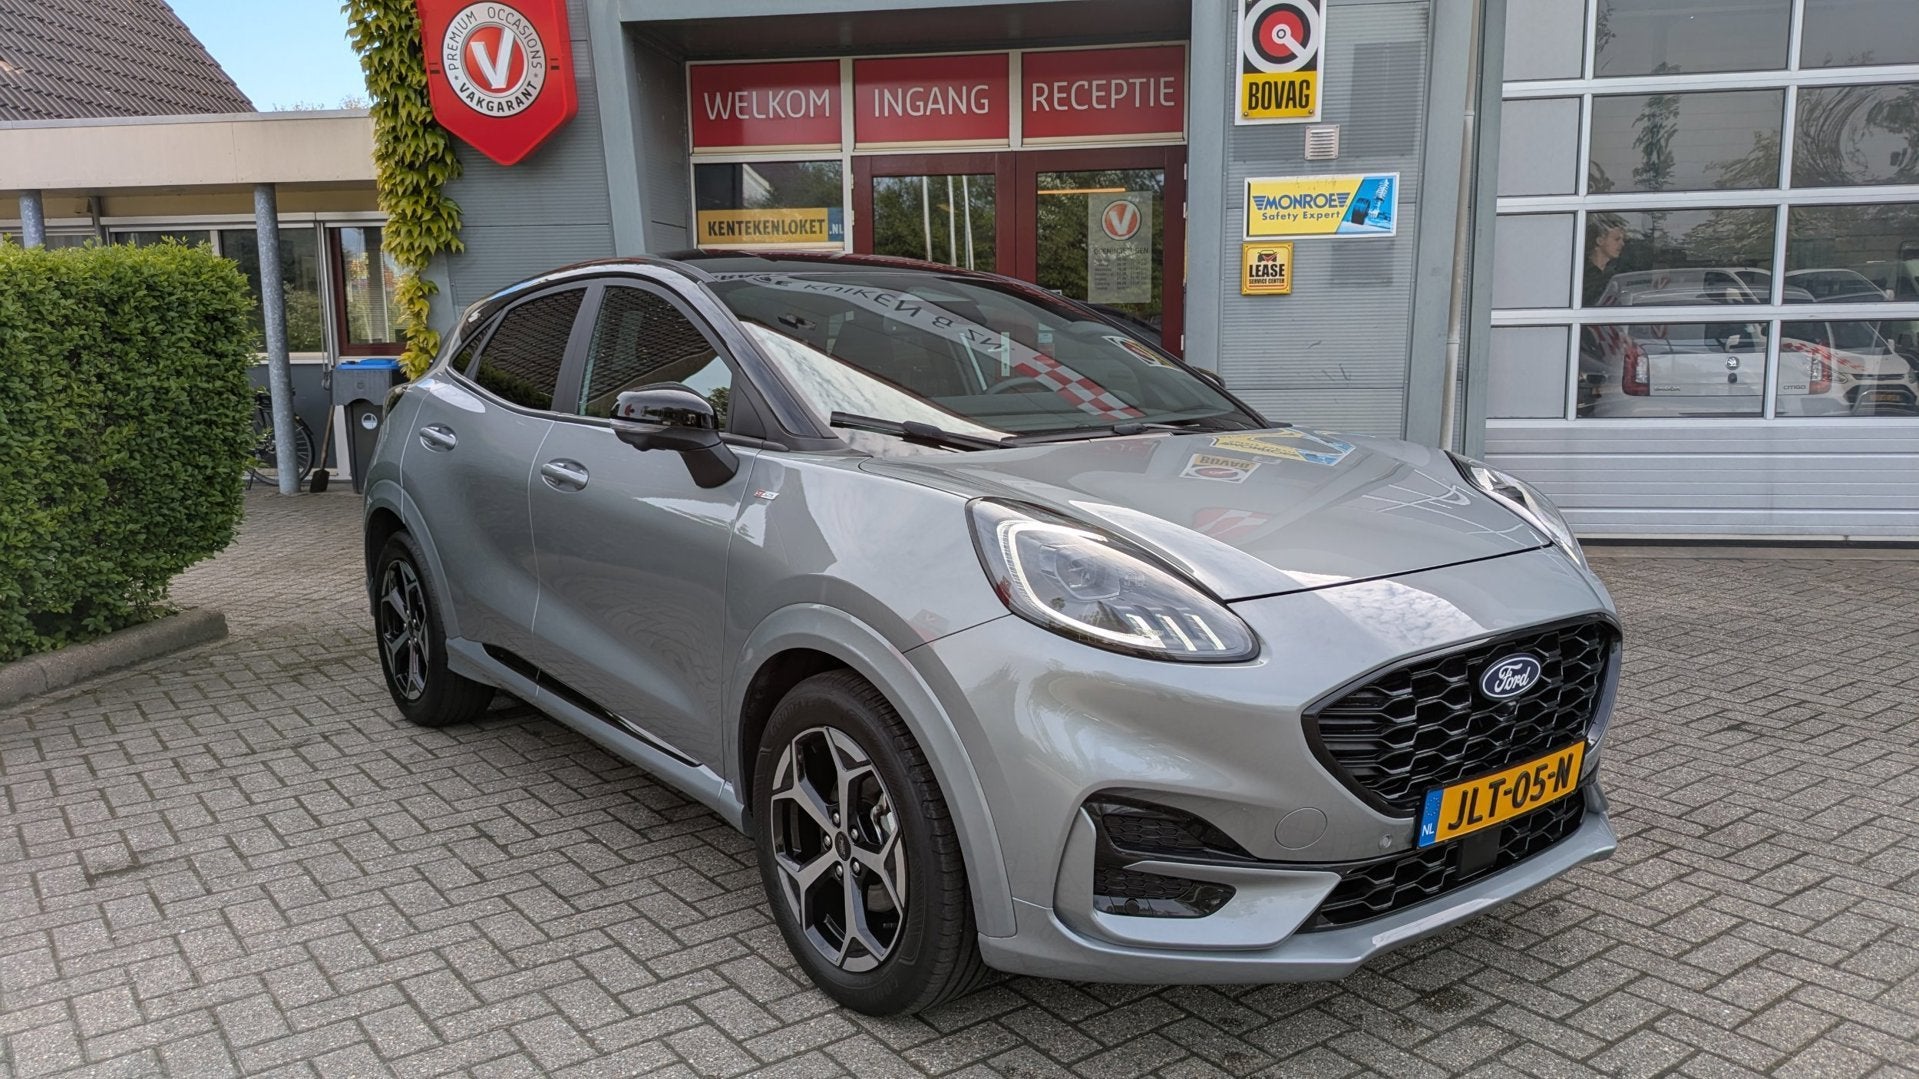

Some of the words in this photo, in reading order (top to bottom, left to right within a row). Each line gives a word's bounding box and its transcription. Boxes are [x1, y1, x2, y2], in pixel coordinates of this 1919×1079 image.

[446, 10, 478, 72] PREMIUM
[486, 6, 543, 70] OCCASIONS
[469, 25, 517, 90] V
[458, 80, 538, 113] VAKGARANT
[703, 88, 831, 121] WELKOM
[873, 84, 990, 118] INGANG
[1031, 76, 1176, 112] RECEPTIE
[1247, 79, 1311, 111] BOVAG
[1261, 211, 1299, 223] Safety
[1302, 210, 1341, 222] Expert
[1263, 191, 1339, 211] MONROE
[1248, 263, 1286, 278] LEASE
[1494, 662, 1532, 694] Ford
[1447, 752, 1574, 831] JLT-05-N
[1421, 822, 1436, 837] NL
